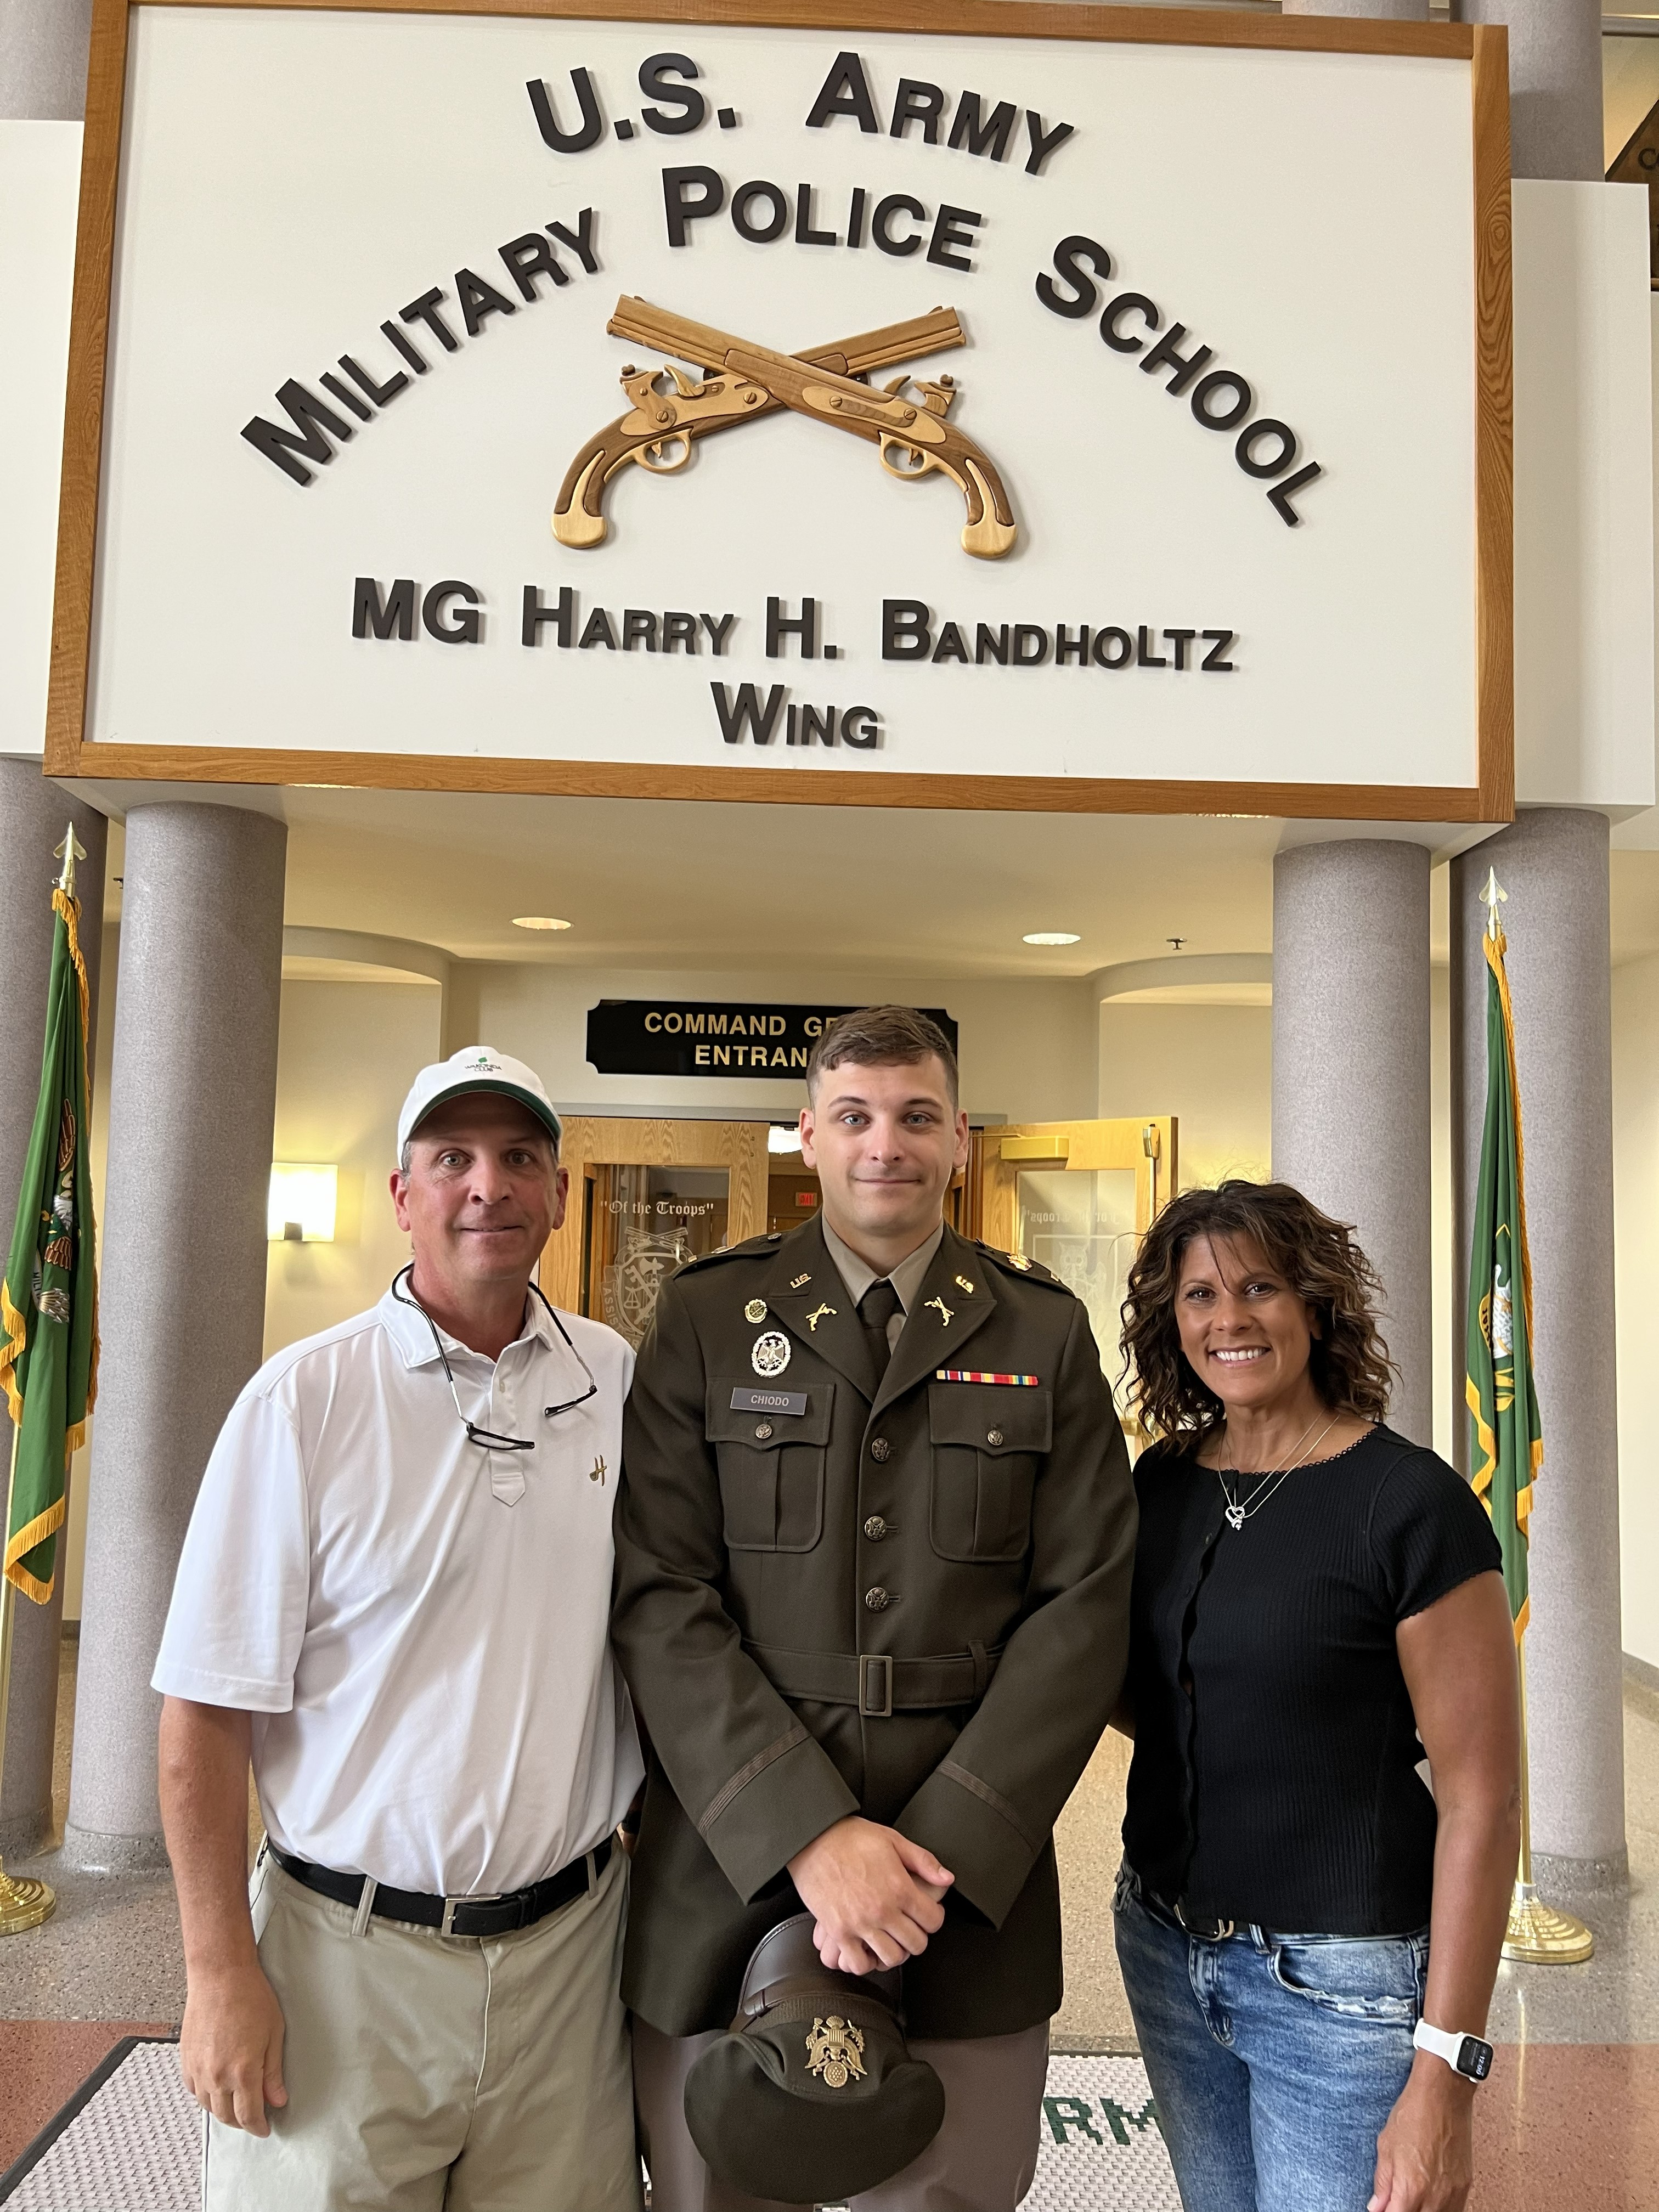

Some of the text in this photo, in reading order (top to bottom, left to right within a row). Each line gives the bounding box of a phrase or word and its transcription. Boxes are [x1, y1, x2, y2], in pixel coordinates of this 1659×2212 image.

[526, 51, 1075, 176] U.S. ARMY
[240, 165, 1322, 527] MILITARY POLICE SCHOOL
[352, 577, 1234, 672] MG HARRY H. BANDHOLTZ
[710, 681, 879, 749] WING
[644, 1012, 786, 1036] COMMAND
[632, 1201, 652, 1216] the
[799, 1193, 814, 1206] EXIT
[751, 1395, 789, 1407] CHIODO
